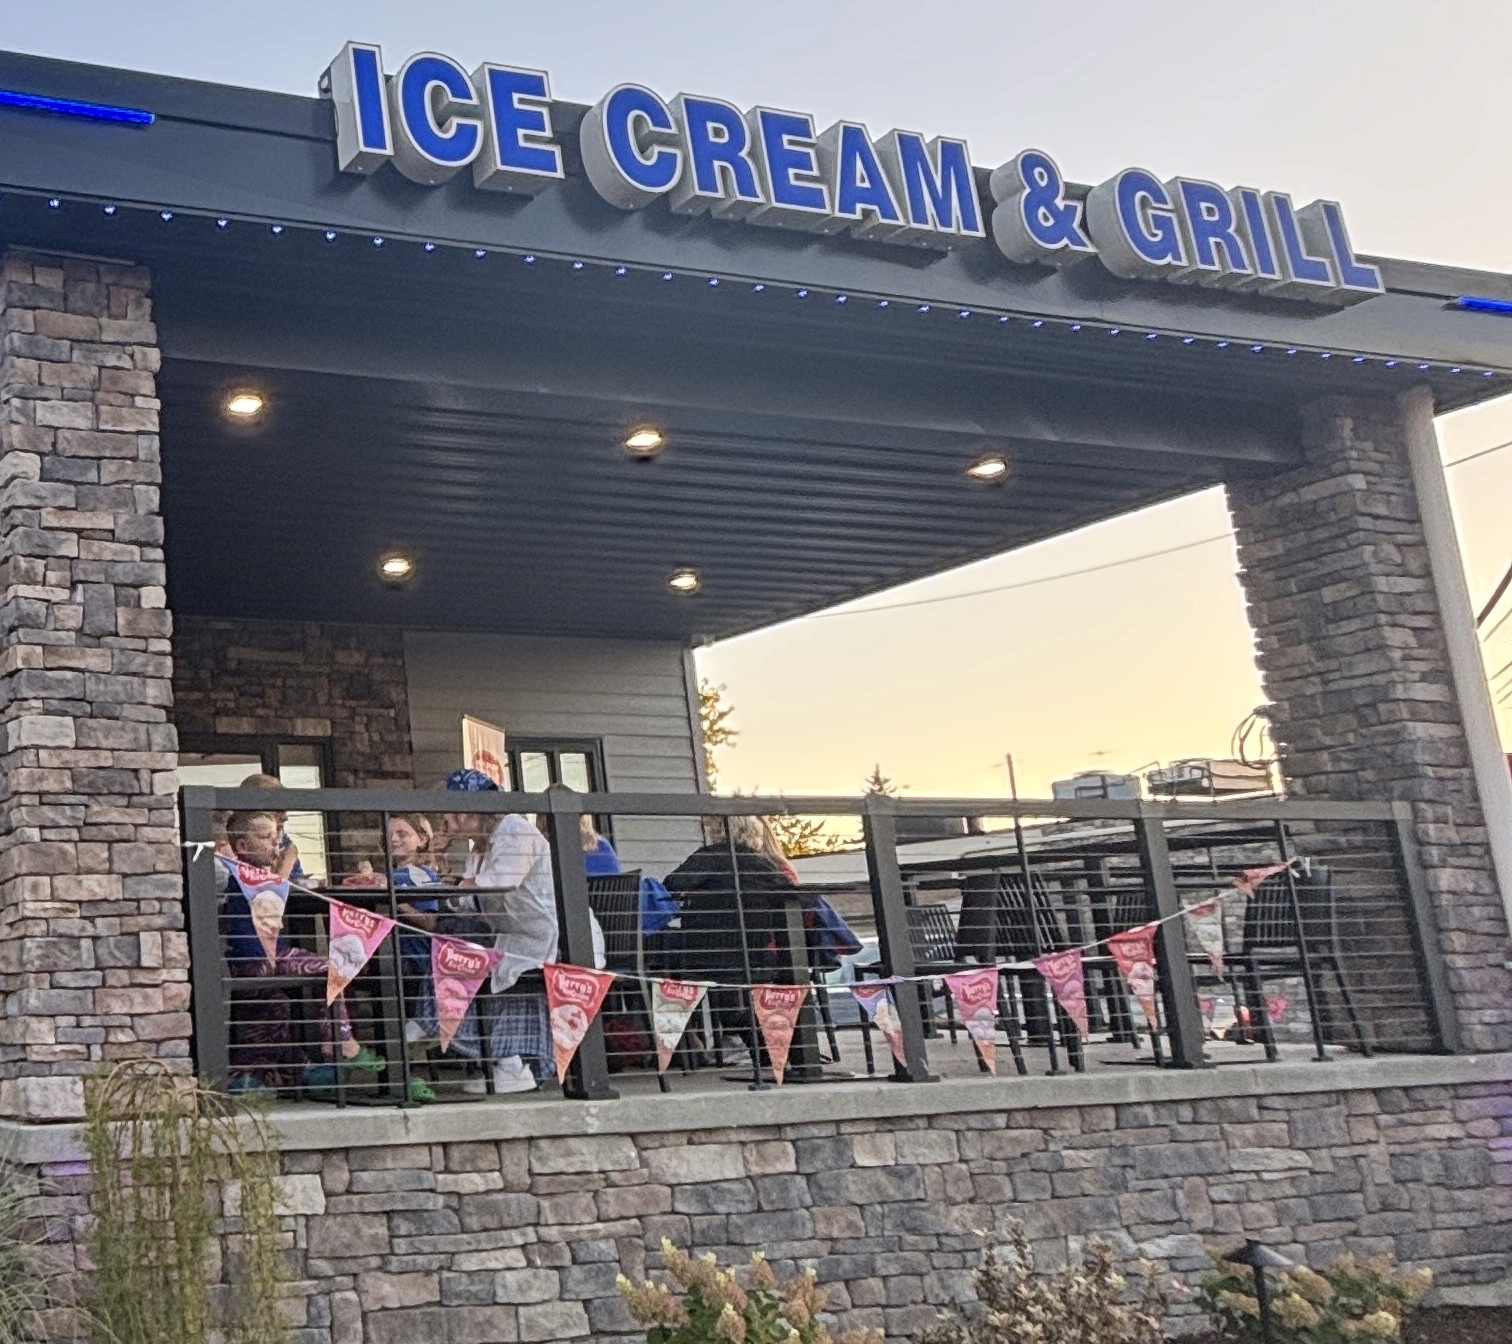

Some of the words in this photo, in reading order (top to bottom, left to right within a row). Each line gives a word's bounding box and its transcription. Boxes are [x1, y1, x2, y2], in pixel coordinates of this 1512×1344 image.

[348, 41, 565, 179] ICE
[603, 84, 986, 238] CREAM
[1018, 150, 1097, 254] &
[1115, 168, 1386, 294] GRILL
